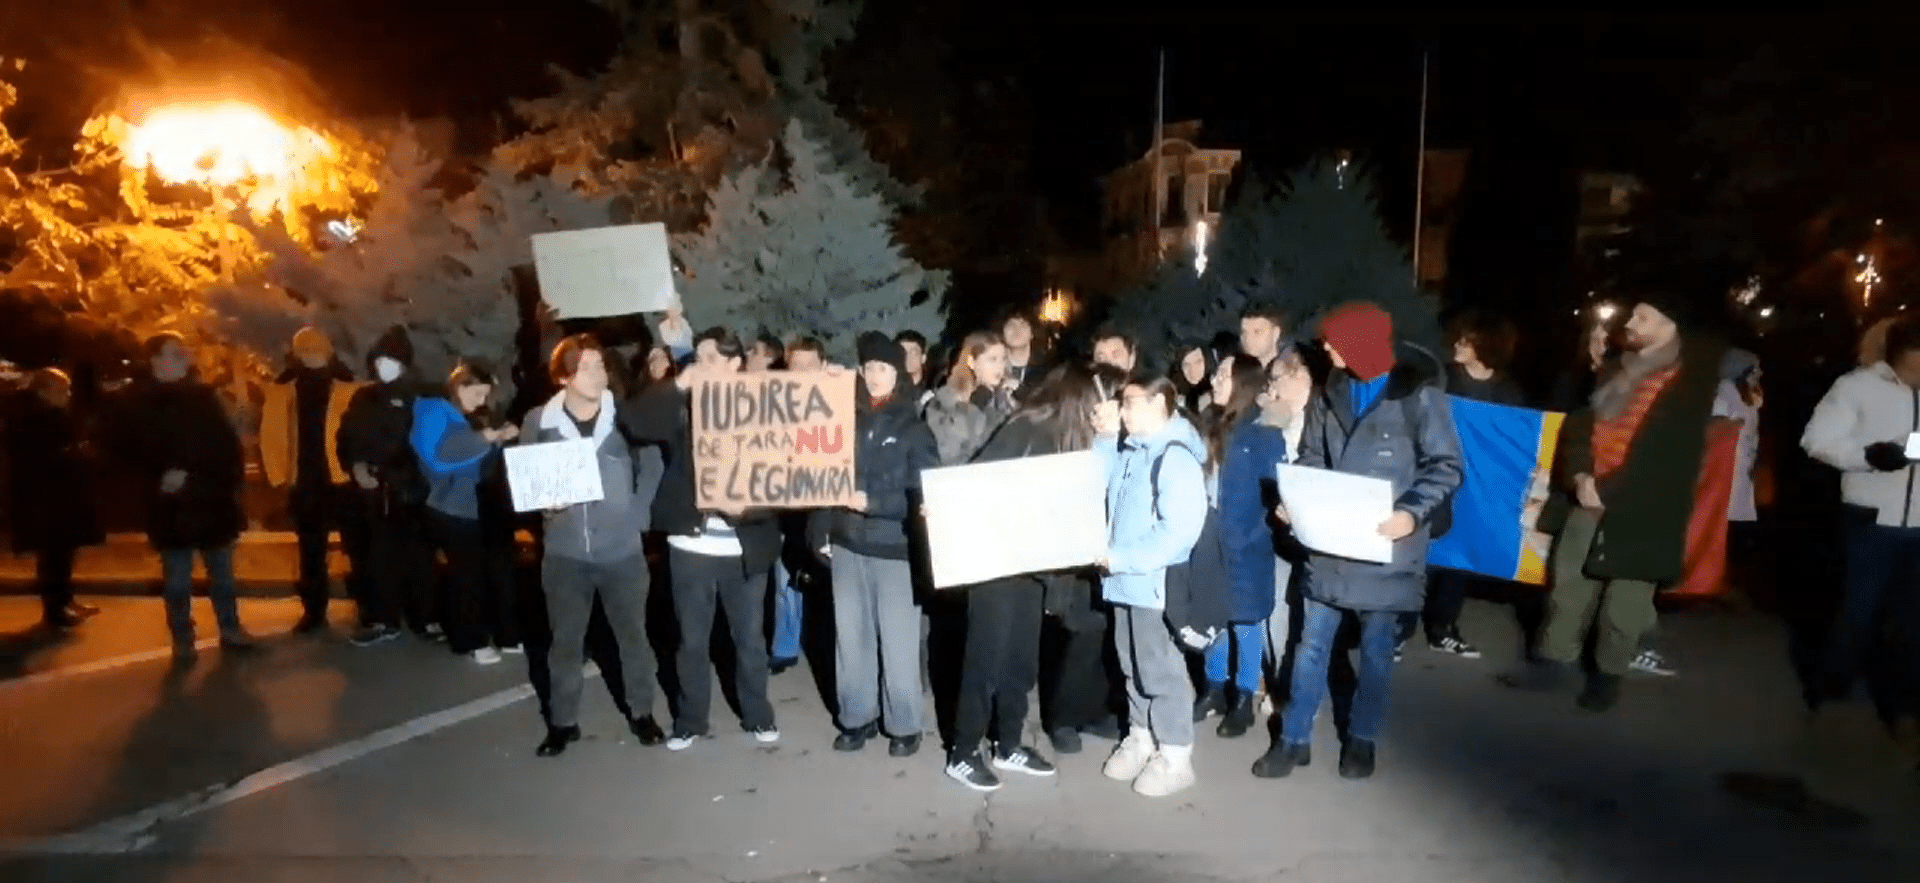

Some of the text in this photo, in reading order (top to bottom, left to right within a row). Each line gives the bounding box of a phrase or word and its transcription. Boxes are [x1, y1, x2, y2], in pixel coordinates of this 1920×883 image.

[701, 379, 833, 430] IUBIREA
[698, 435, 720, 458] DE
[795, 425, 844, 455] NU
[700, 467, 718, 502] E
